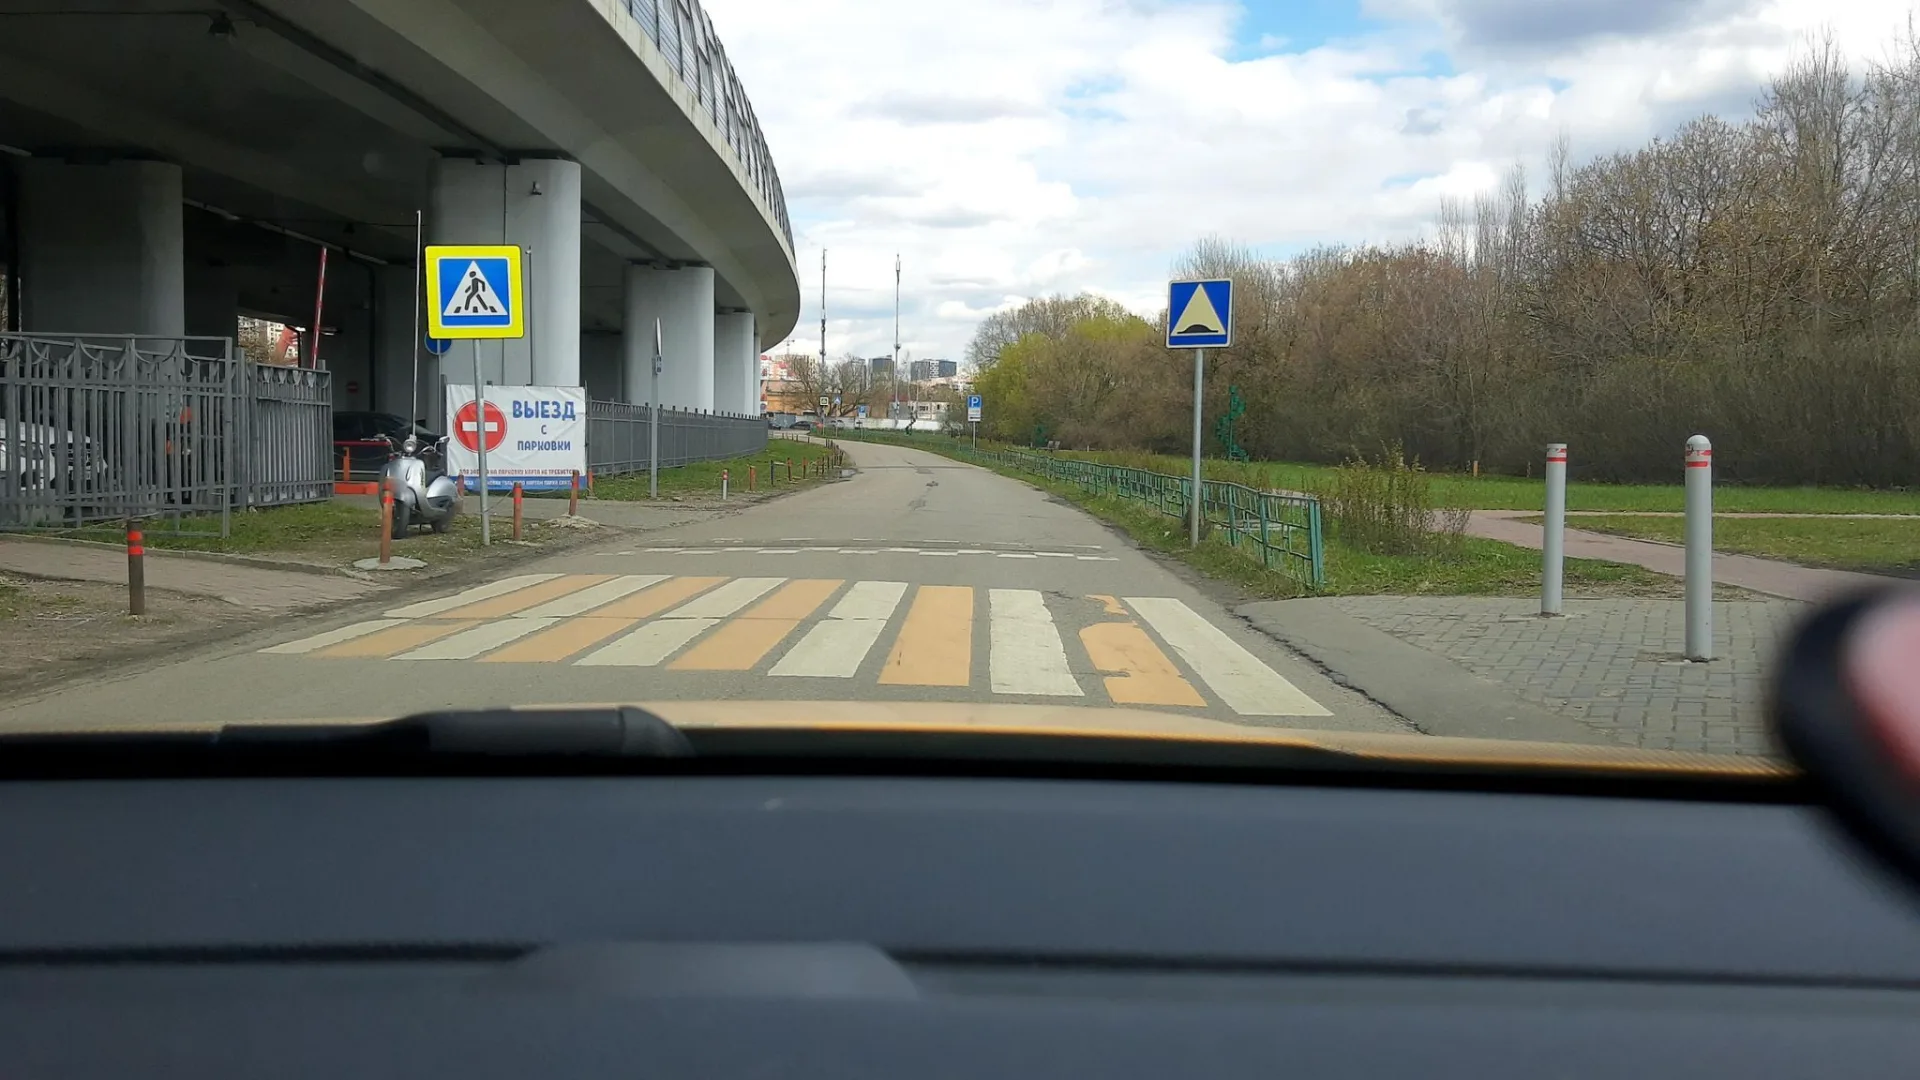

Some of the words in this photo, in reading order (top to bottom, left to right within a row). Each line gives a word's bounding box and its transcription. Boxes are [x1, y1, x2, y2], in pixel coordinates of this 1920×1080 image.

[971, 396, 979, 408] P
[512, 400, 576, 421] ВЫЕЗД
[517, 440, 571, 451] ПАРКОВКИ
